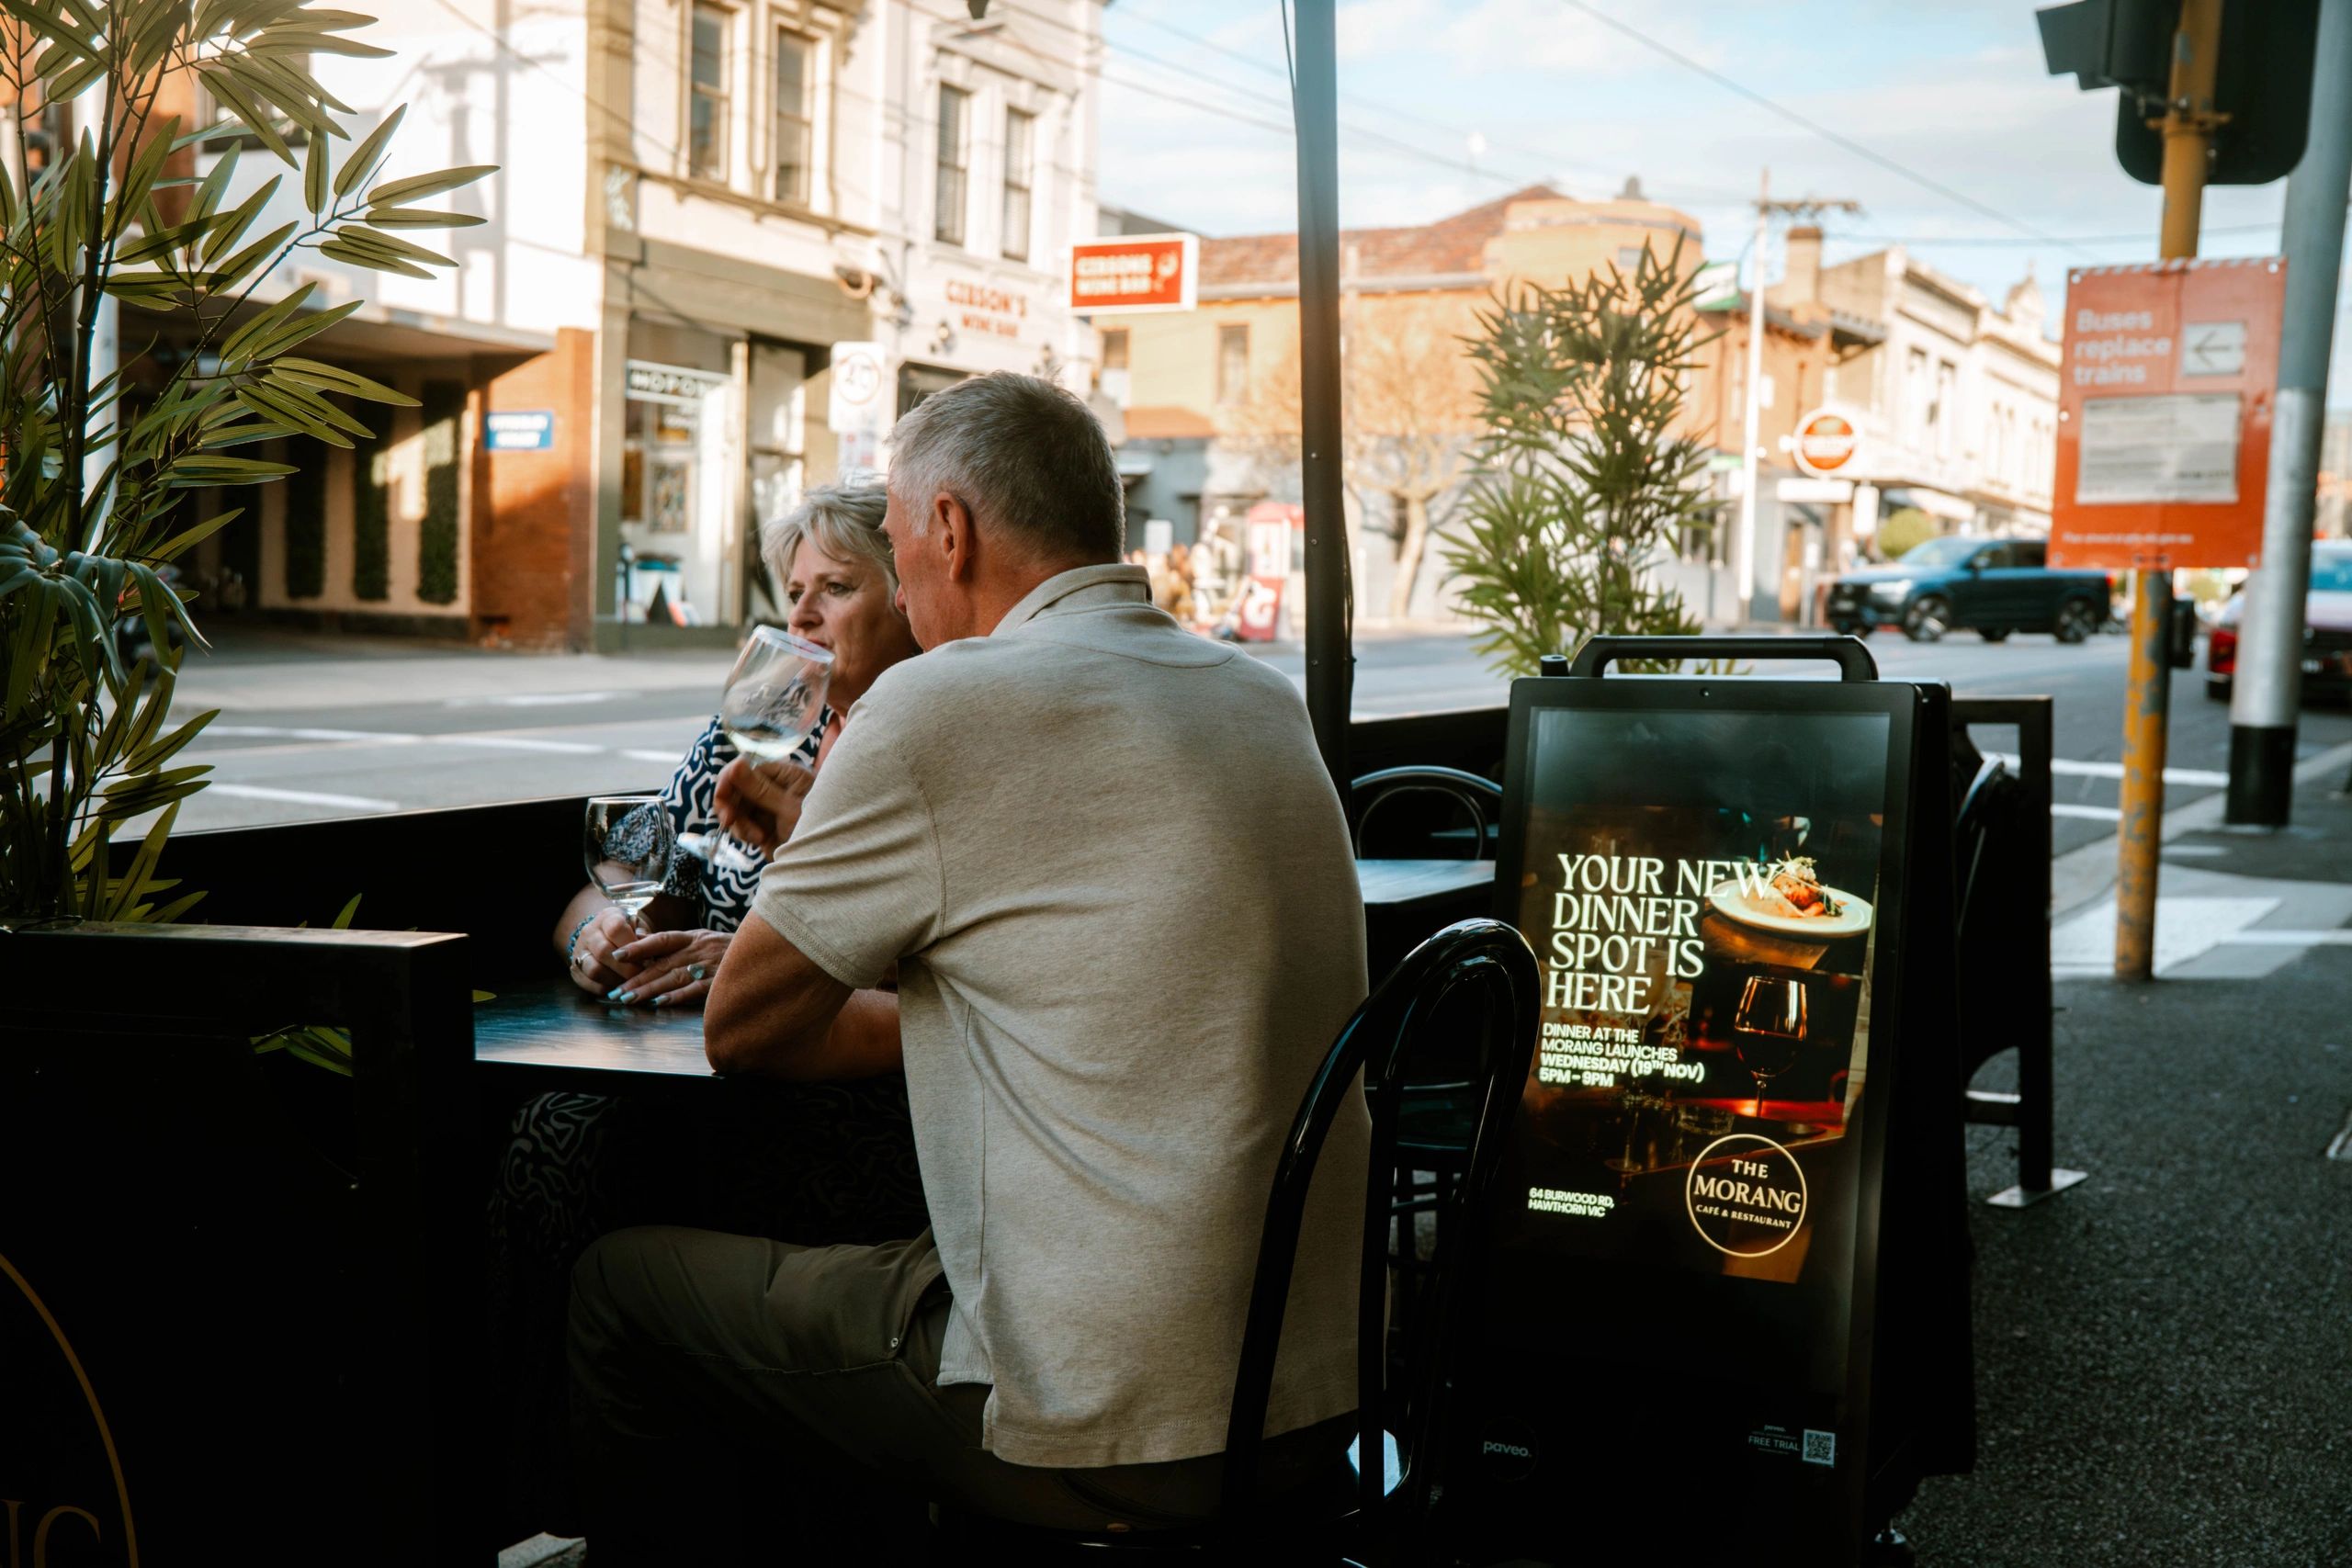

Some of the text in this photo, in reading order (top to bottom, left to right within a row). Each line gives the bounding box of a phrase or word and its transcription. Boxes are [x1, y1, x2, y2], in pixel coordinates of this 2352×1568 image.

[2076, 309, 2153, 333] Buses
[2075, 334, 2172, 362] replace
[2074, 362, 2146, 386] trains
[1557, 853, 1779, 900] YOUR NEW
[1553, 892, 1699, 937] DINNER
[1550, 931, 1705, 978] SPOT IS
[1545, 970, 1652, 1015] HERE
[1542, 1022, 1639, 1043] DINNER AT THE
[1541, 1038, 1679, 1062] MORANG LAUNCHES
[1539, 1066, 1571, 1084] 5PM
[1581, 1071, 1614, 1088] 9PM
[1540, 1052, 1630, 1074] WEDNESDAY
[1663, 1062, 1705, 1083] NOV)
[1731, 1158, 1769, 1179] THE
[1529, 1187, 1614, 1209] 64 BURWOOD RD,
[1693, 1174, 1801, 1213] MORANG
[1528, 1199, 1606, 1218] HAWTHORN VIC
[1695, 1204, 1792, 1229] CAFÉ & RESTAURANT
[1748, 1435, 1771, 1447] FREE
[1774, 1438, 1801, 1451] TRIAL
